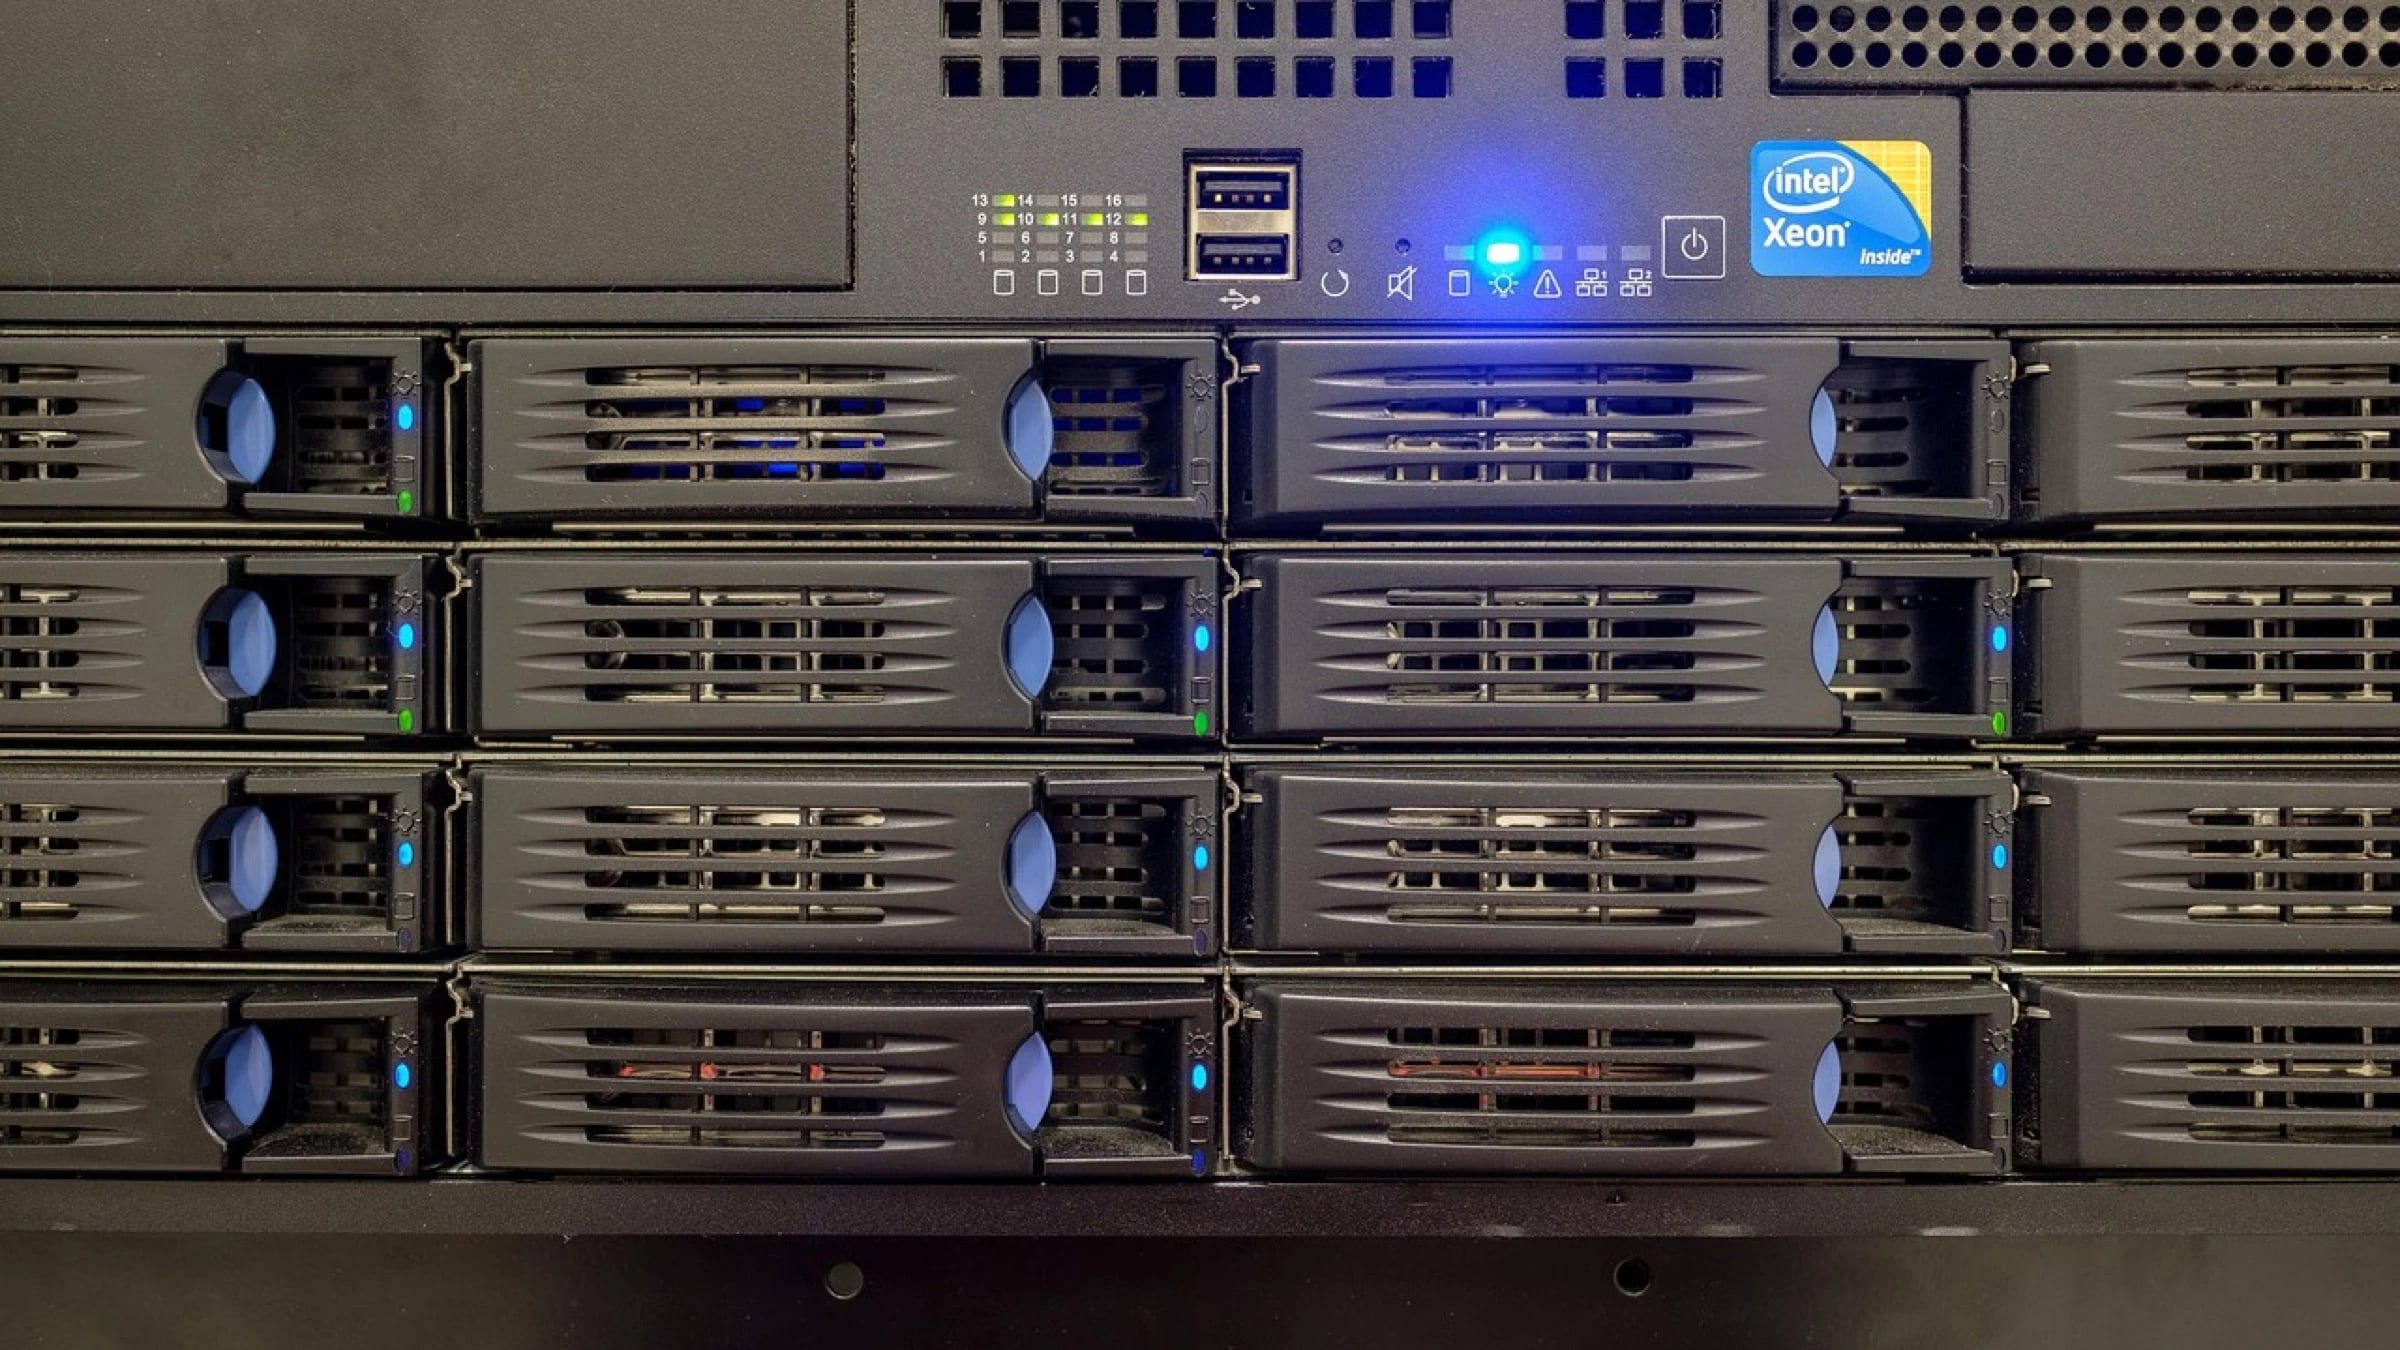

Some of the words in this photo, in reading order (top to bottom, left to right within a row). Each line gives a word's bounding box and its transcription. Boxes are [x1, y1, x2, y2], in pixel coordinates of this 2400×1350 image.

[1775, 166, 1840, 194] intel
[972, 193, 988, 207] 13
[1017, 193, 1033, 207] 14
[1060, 193, 1077, 207] 15
[1105, 193, 1122, 207] 16
[978, 213, 987, 226] 9
[1017, 213, 1034, 226] 10
[1062, 213, 1077, 226] 11
[1105, 213, 1122, 226] 12
[978, 231, 987, 244] 5
[1021, 231, 1030, 244] 6
[1065, 231, 1074, 244] 7
[1109, 231, 1119, 244] 8
[1021, 250, 1030, 263] 2
[1065, 250, 1075, 263] 3
[1109, 250, 1119, 263] 4
